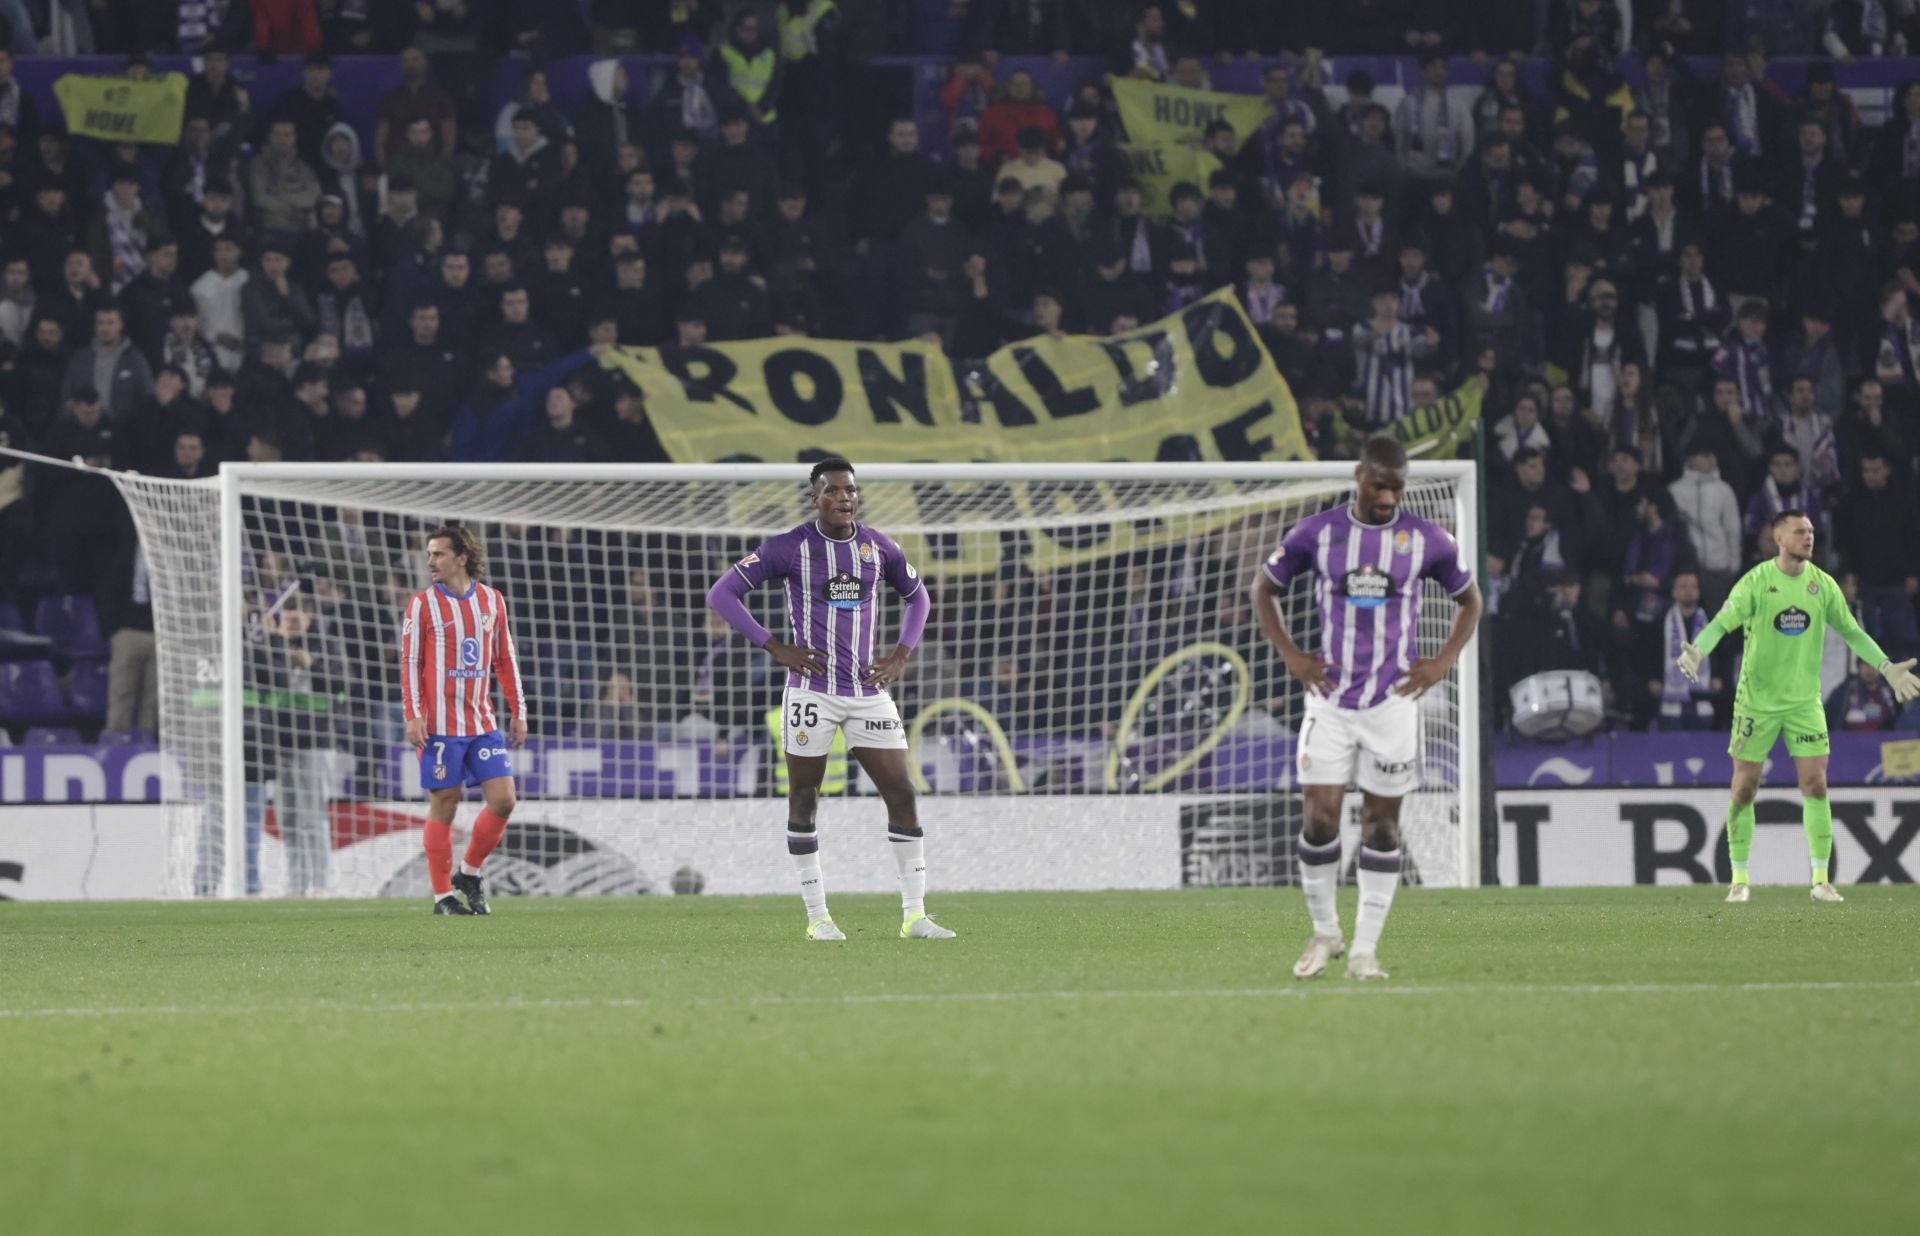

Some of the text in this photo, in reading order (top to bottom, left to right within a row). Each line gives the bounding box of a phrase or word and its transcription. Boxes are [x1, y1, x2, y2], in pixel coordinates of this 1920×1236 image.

[658, 298, 1262, 428] RONALDO
[829, 581, 860, 591] Estrella
[830, 590, 859, 600] Galicia
[790, 702, 818, 728] 35
[865, 720, 903, 731] INEX
[1735, 716, 1755, 738] 13
[433, 741, 446, 765] 7
[1619, 801, 1920, 885] BOX
